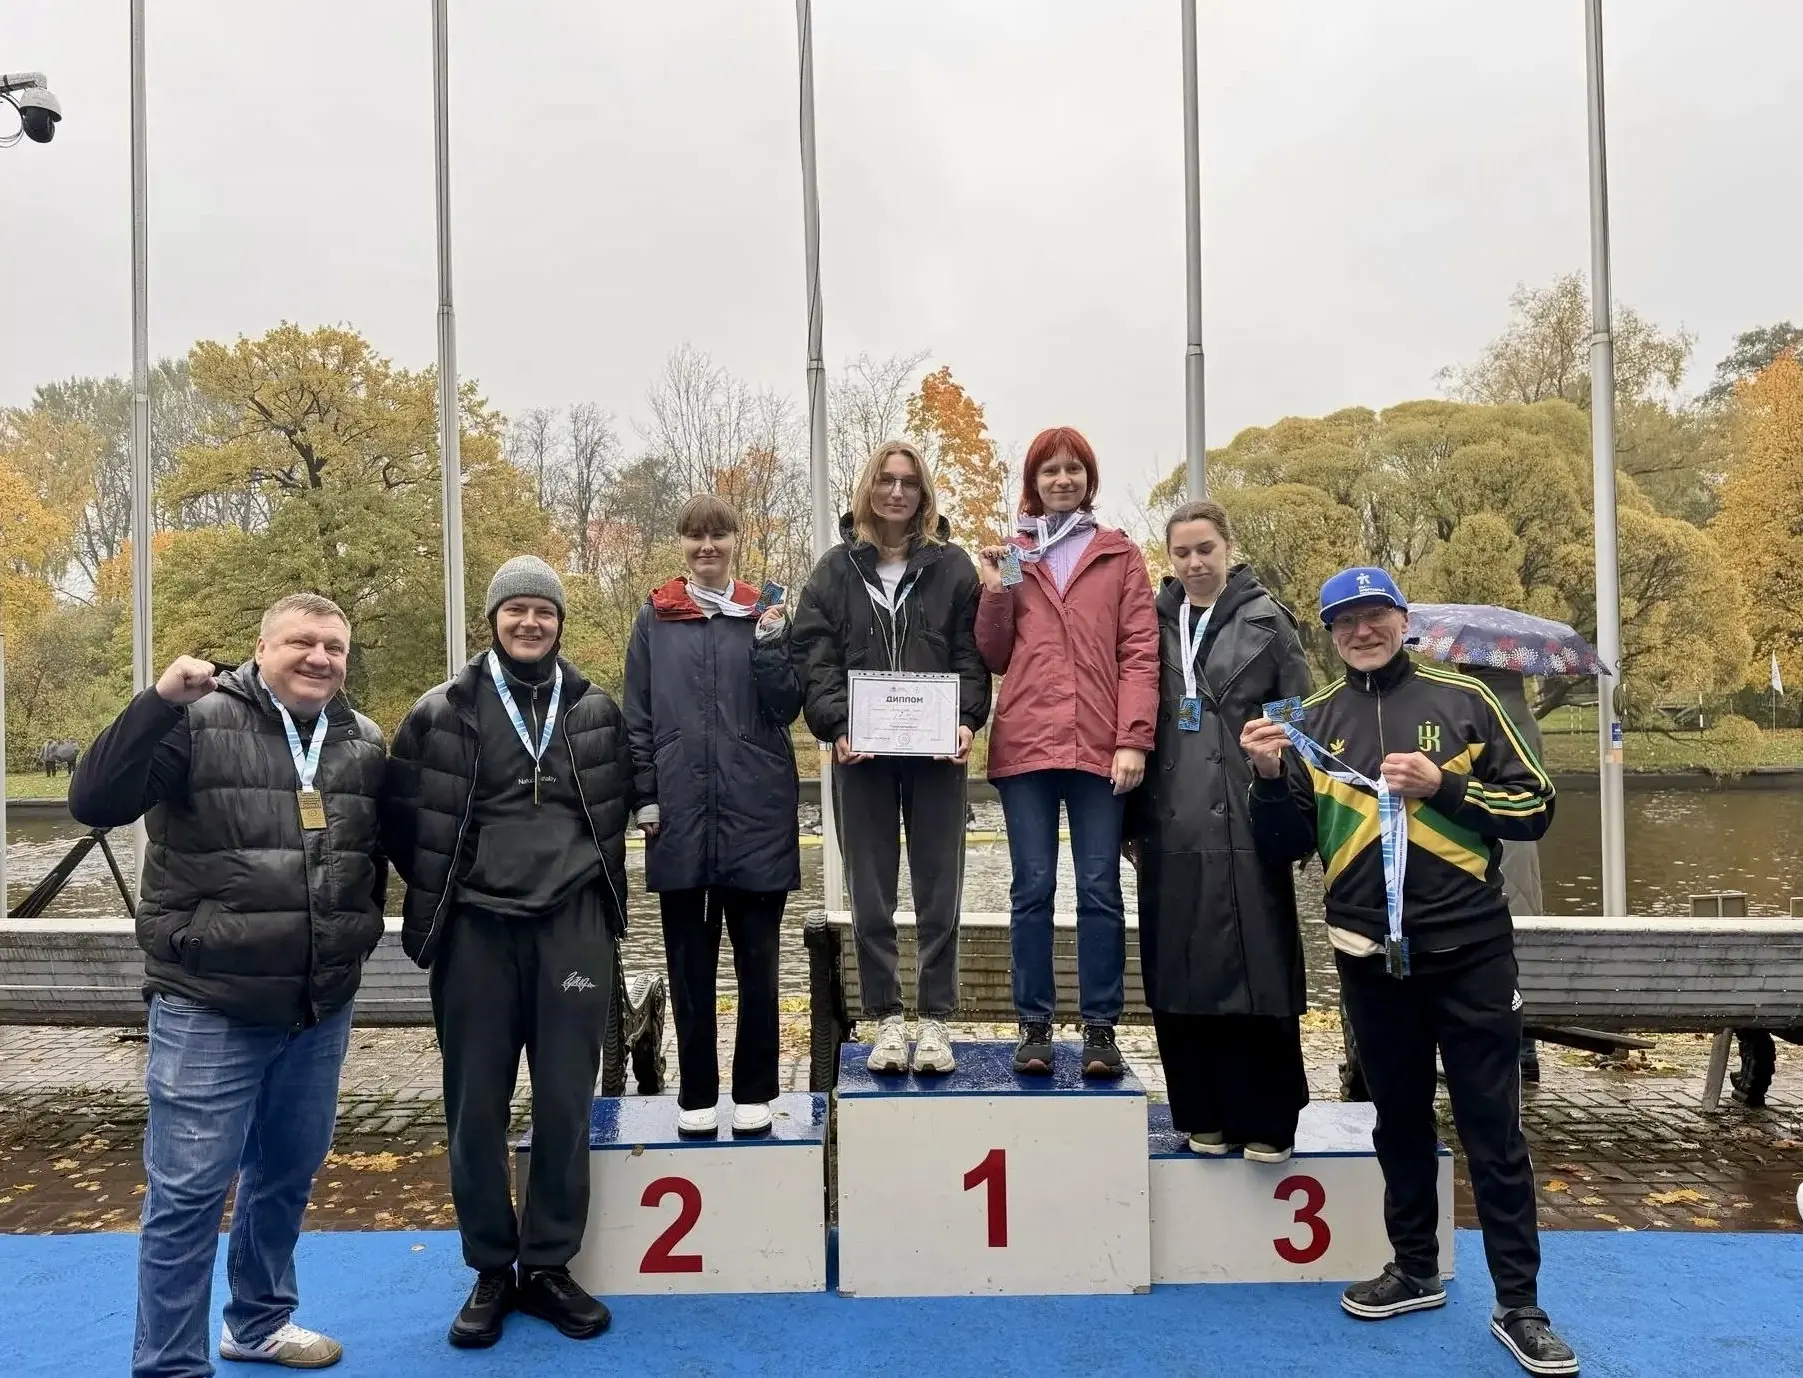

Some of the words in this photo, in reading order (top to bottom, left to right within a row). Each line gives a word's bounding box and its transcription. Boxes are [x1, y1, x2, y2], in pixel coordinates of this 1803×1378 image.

[886, 695, 924, 704] ДИПЛОМ
[640, 1177, 702, 1274] 2
[964, 1149, 1007, 1247] 1
[1274, 1176, 1330, 1263] 3
